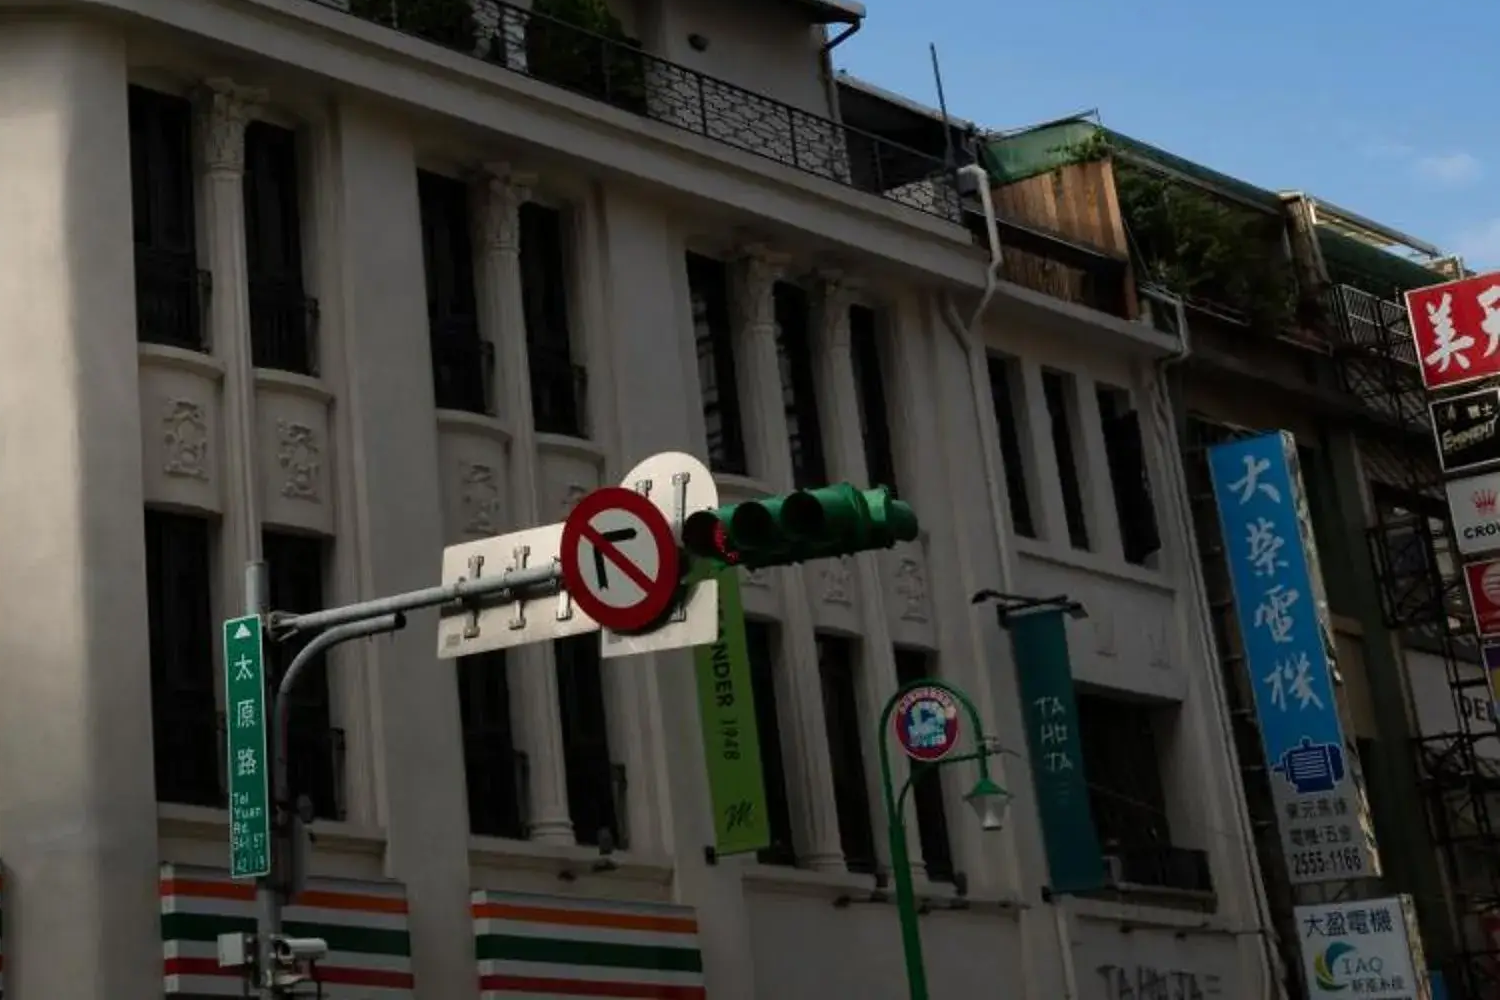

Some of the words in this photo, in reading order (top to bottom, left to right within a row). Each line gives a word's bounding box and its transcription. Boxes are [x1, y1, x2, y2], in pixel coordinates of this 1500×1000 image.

[235, 653, 258, 777] 太原路
[720, 719, 741, 761] 1948
[1303, 907, 1394, 937] 大盈電機
